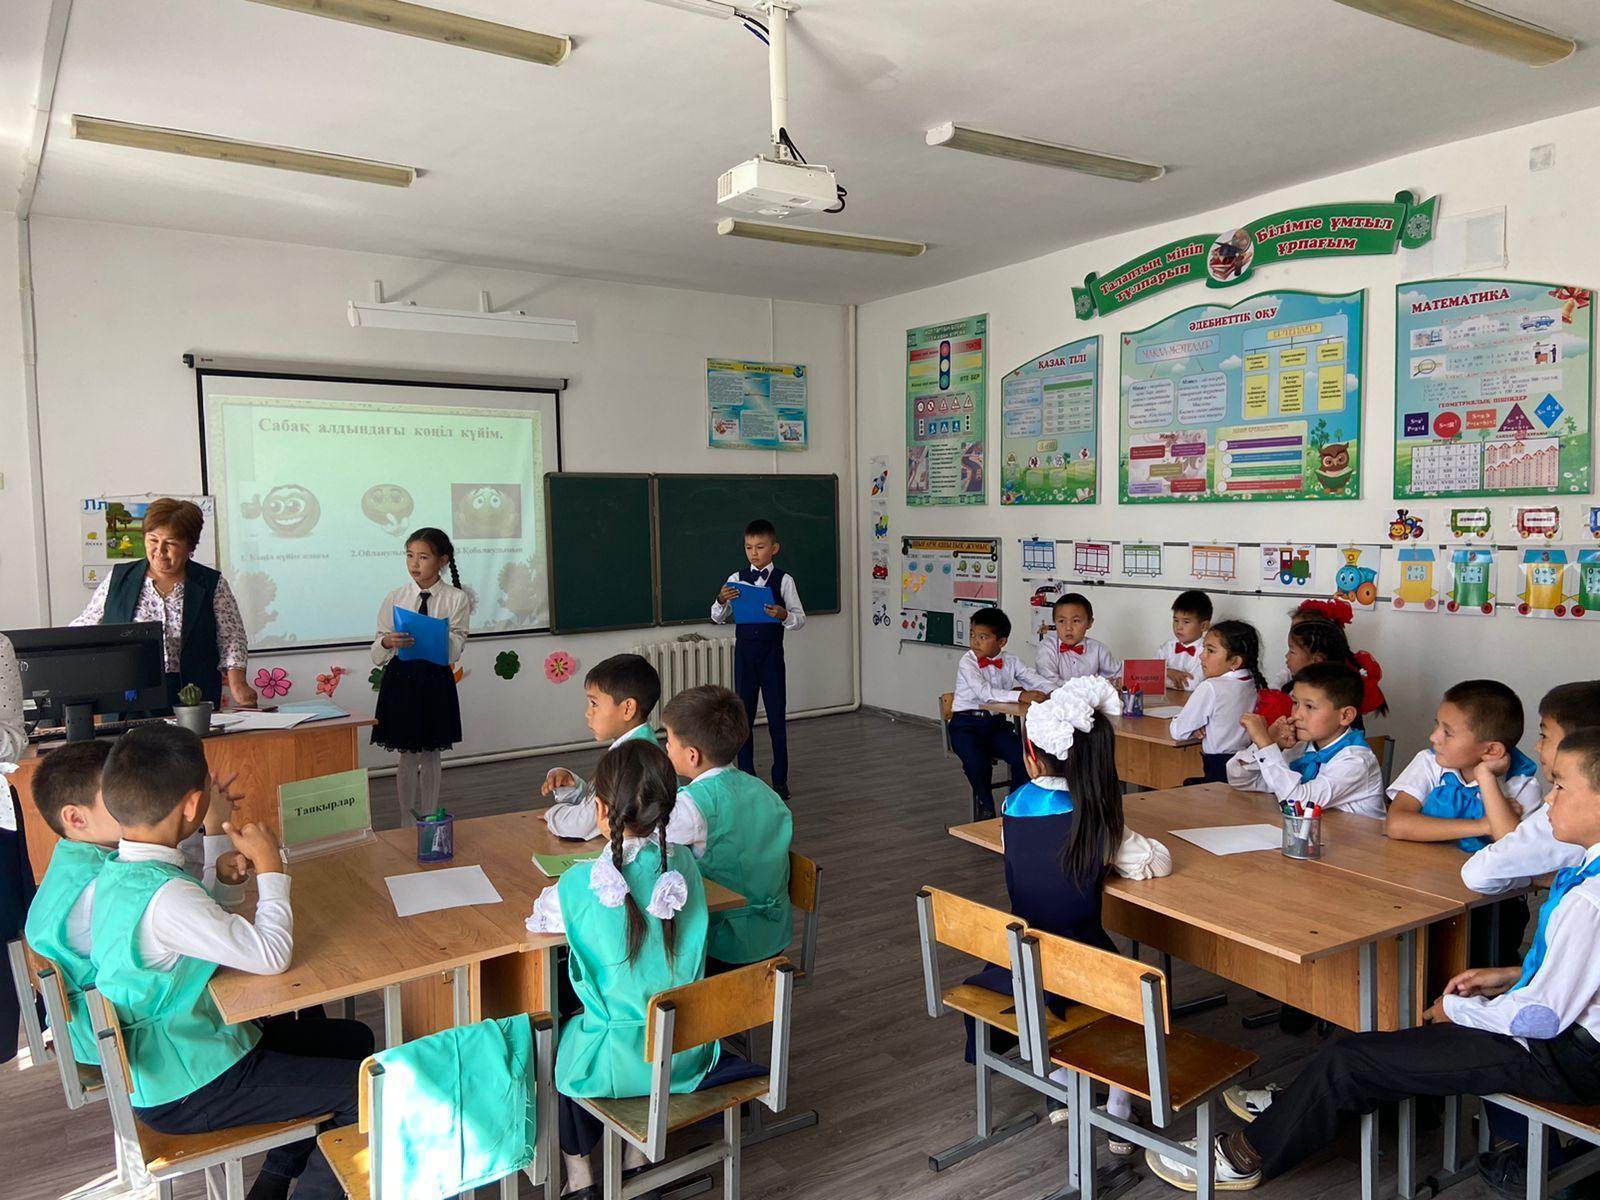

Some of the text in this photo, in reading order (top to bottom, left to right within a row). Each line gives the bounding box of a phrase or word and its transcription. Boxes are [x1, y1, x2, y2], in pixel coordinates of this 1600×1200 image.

[1255, 217, 1394, 244] Білімге ұмтыл
[1277, 237, 1357, 256] ұрпағым
[1100, 243, 1204, 295] Талаптың мініп
[1115, 264, 1190, 302] тұлпарын
[1411, 288, 1510, 314] МАТЕМАТИКА
[1189, 312, 1251, 331] ӘДЕБИЕТТІК
[318, 423, 406, 437] алдындағы
[461, 426, 504, 442] күйім.
